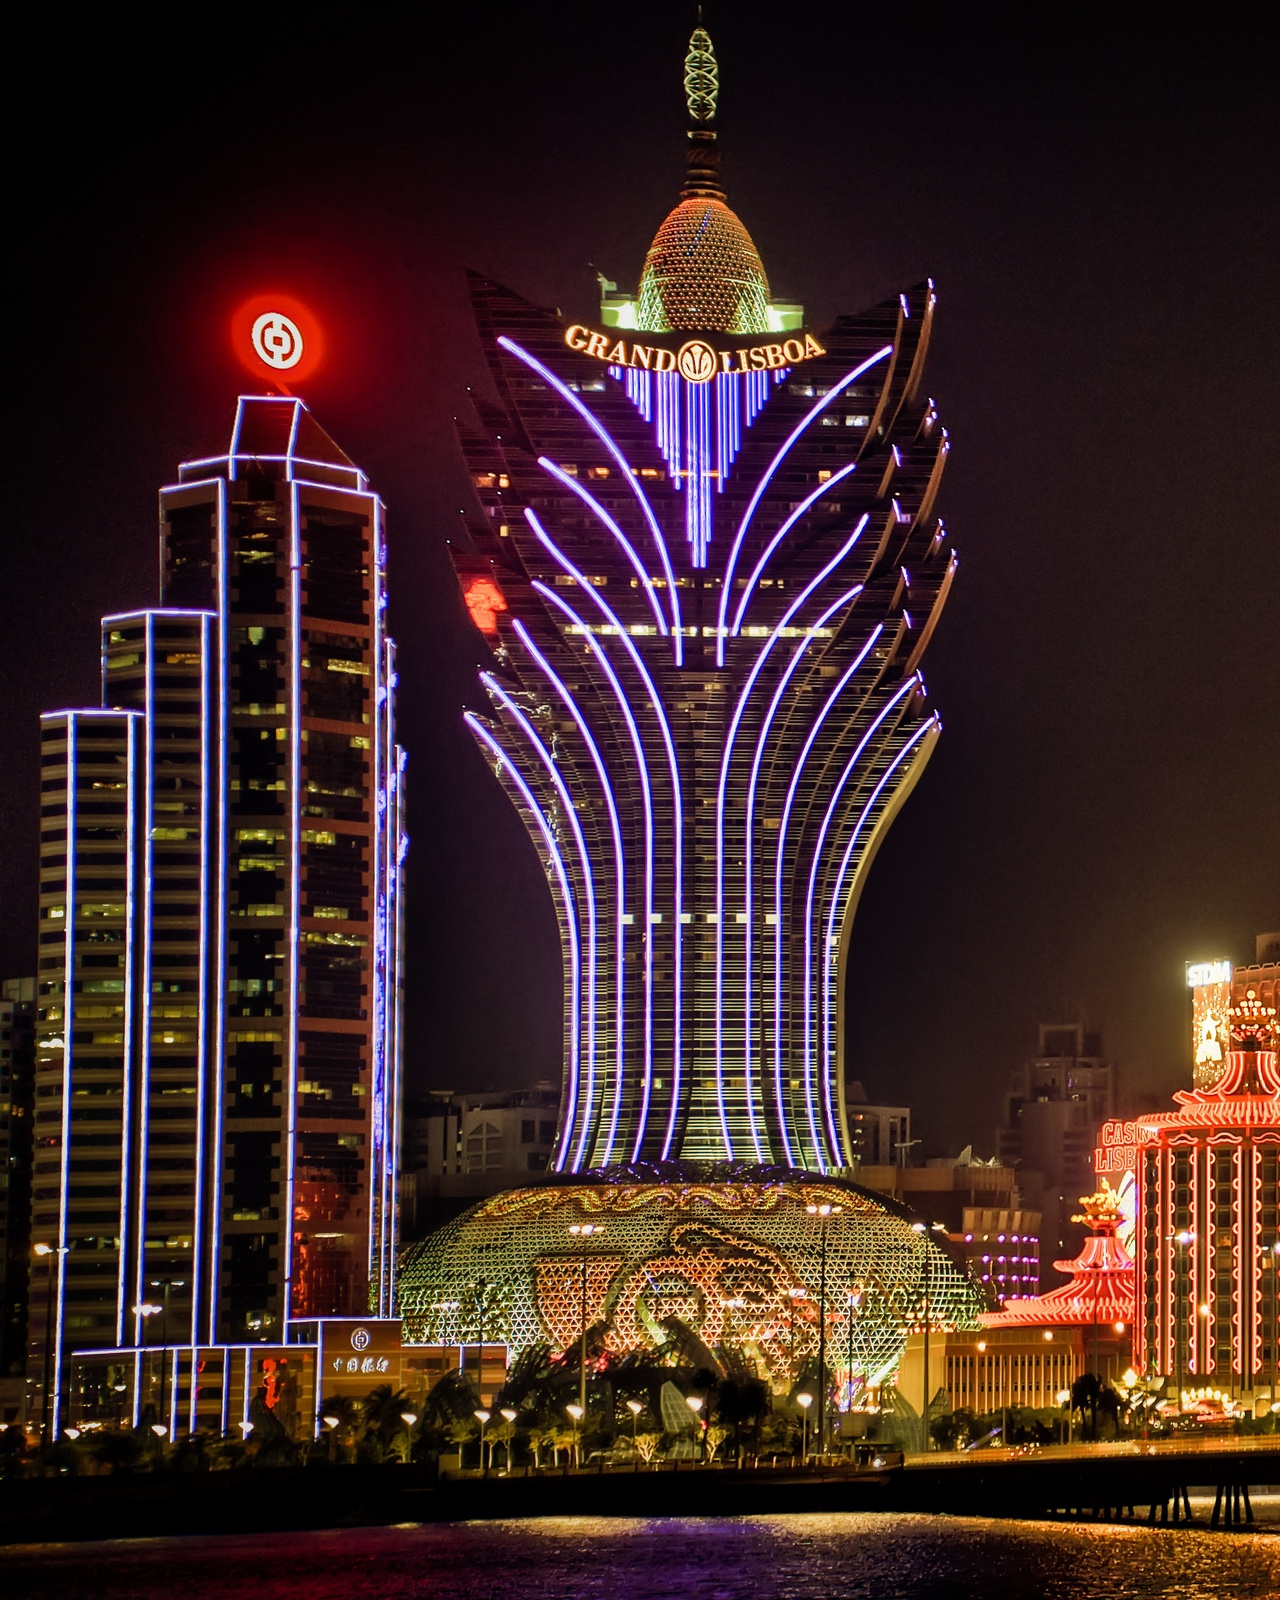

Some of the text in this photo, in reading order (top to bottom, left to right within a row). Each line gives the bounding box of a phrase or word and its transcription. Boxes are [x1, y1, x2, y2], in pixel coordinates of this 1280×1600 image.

[564, 325, 826, 374] GRAND LISBOA
[1188, 961, 1231, 987] STDM
